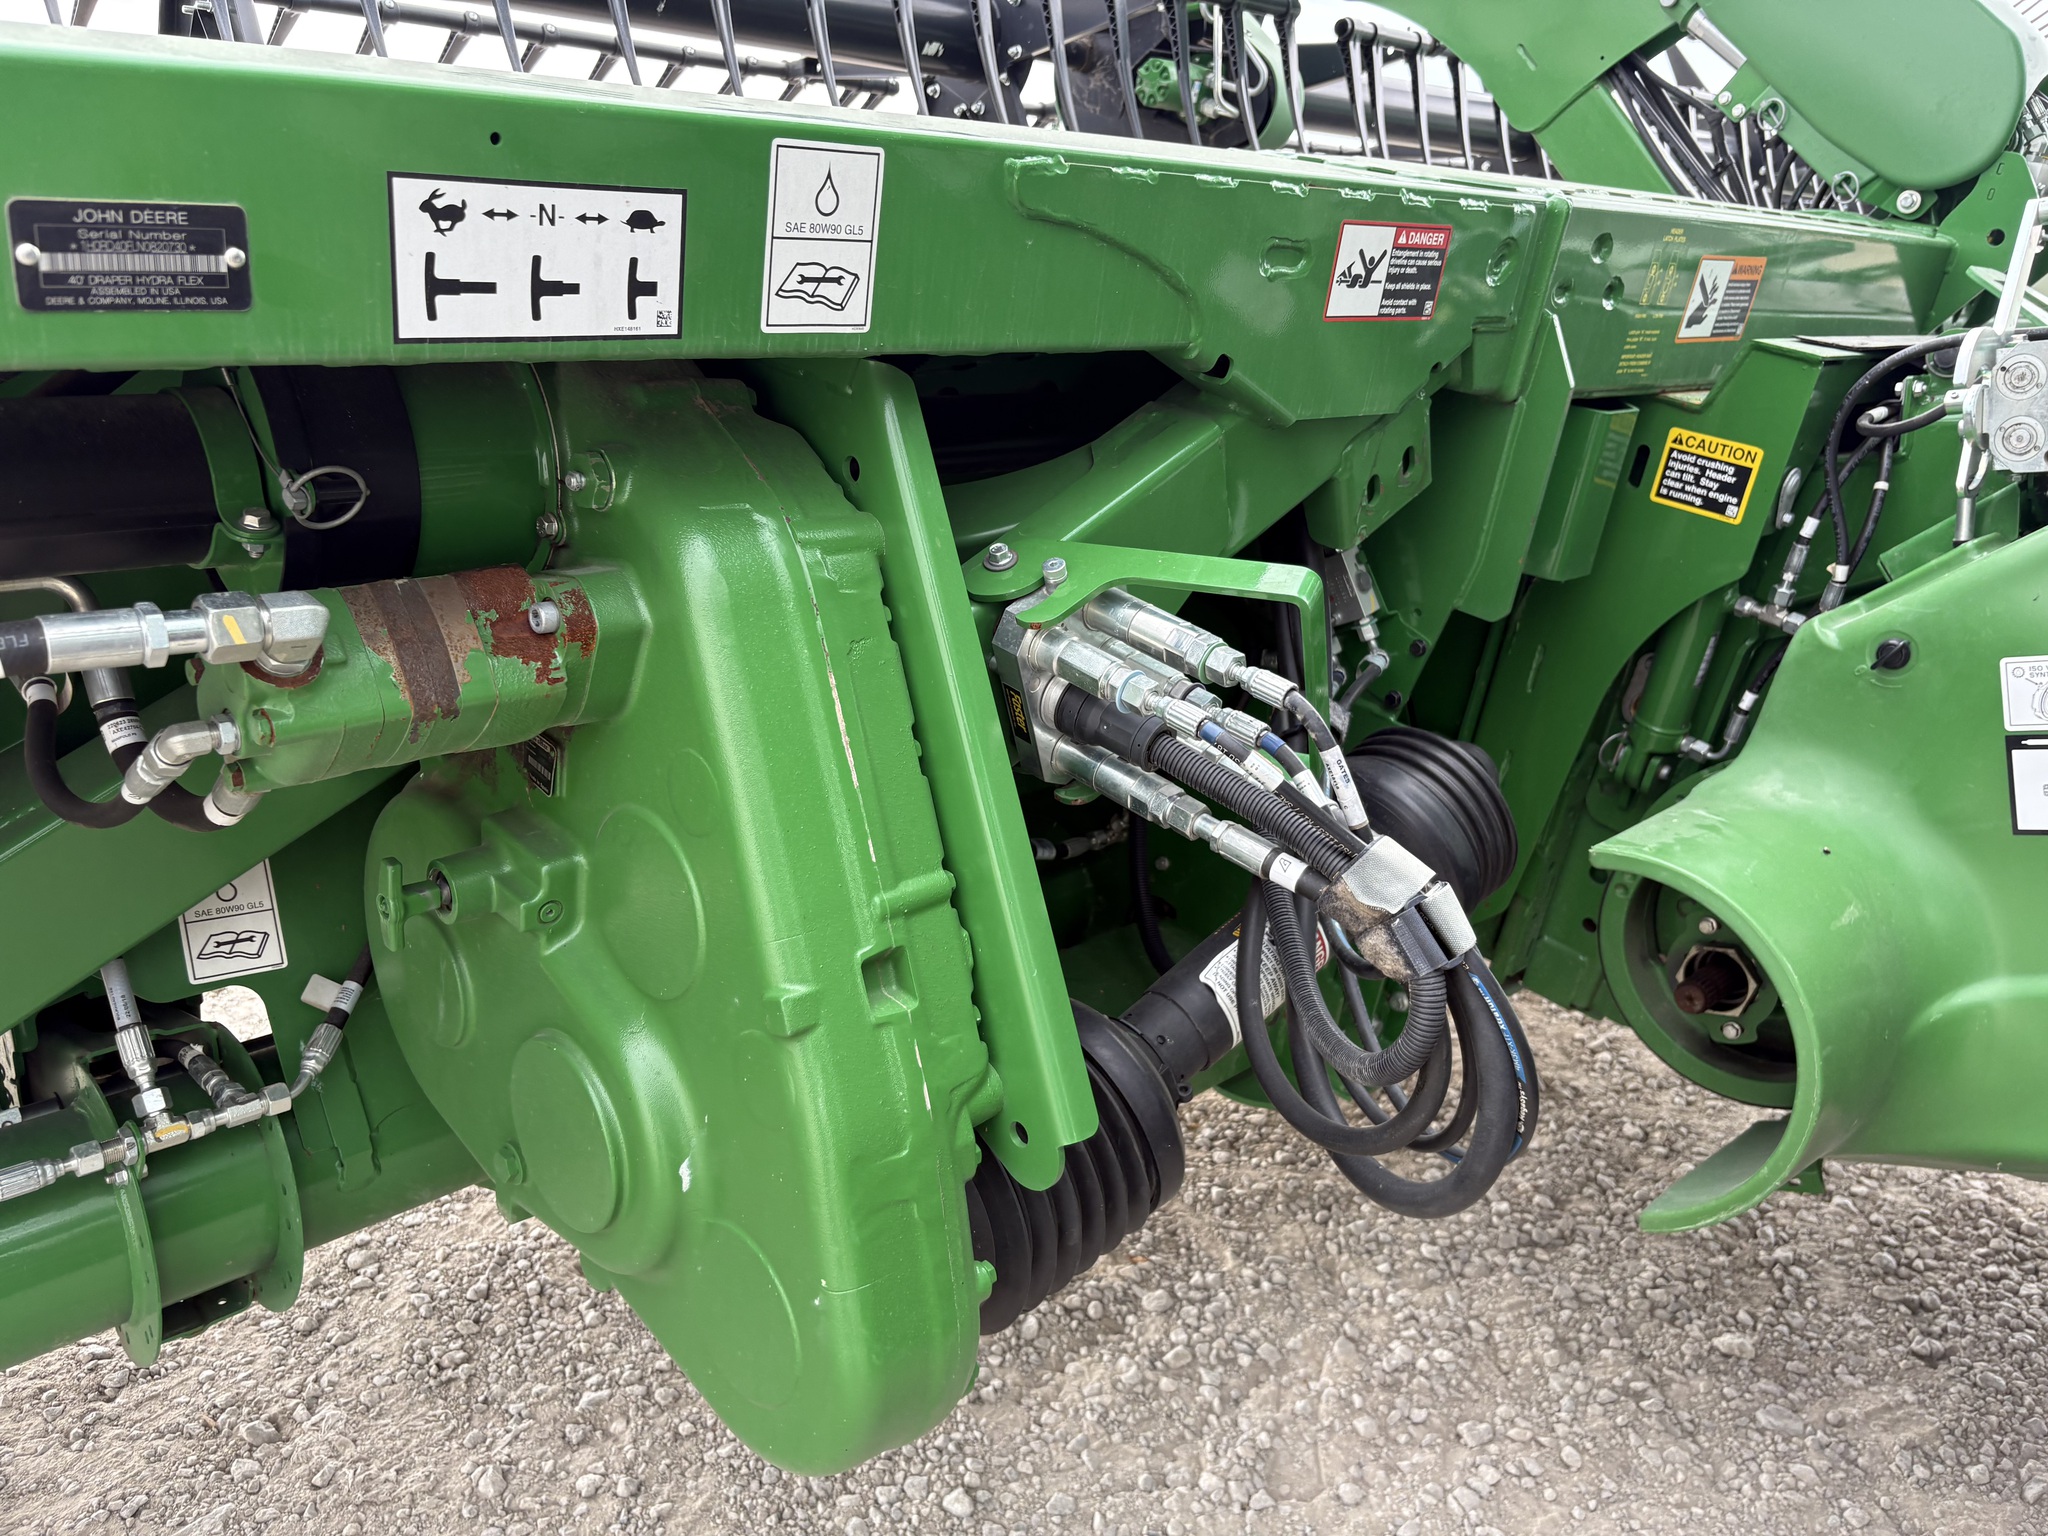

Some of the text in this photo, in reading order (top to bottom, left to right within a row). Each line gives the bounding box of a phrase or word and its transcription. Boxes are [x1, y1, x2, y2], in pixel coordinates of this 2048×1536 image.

[72, 208, 189, 225] JOHN DEERE
[77, 228, 188, 241] Serial Number
[785, 221, 864, 236] SAE 80W90 GL5
[1408, 232, 1445, 246] DANGER
[1392, 249, 1419, 259] Entanglement
[1424, 250, 1440, 260] rotating
[1427, 259, 1442, 267] serious
[1388, 266, 1400, 275] injury
[1739, 265, 1763, 275] WARNING
[88, 276, 133, 286] DRAPER
[135, 276, 174, 286] HYDRA
[178, 276, 204, 286] FLEX
[1385, 282, 1395, 291] Keep
[90, 287, 181, 296] ASSEMBLED IN USA
[45, 297, 228, 306] DEERE & COMPANY, MOLINE, ILLINOIS, USA
[1381, 298, 1393, 306] Avoid
[1380, 307, 1407, 316] rotating parts.
[1685, 435, 1758, 465] CAUTION
[1670, 449, 1736, 476] Avoid crushing
[1668, 459, 1737, 484] injuries. Header
[1665, 469, 1720, 491] can tilt. Stay
[1660, 486, 1704, 507] is running.
[1662, 478, 1739, 505] clear when engine
[2028, 665, 2044, 673] ISO
[1010, 690, 1028, 734] Faster
[1336, 759, 1350, 784] GATES
[194, 900, 265, 918] SAE 80W90 GL5
